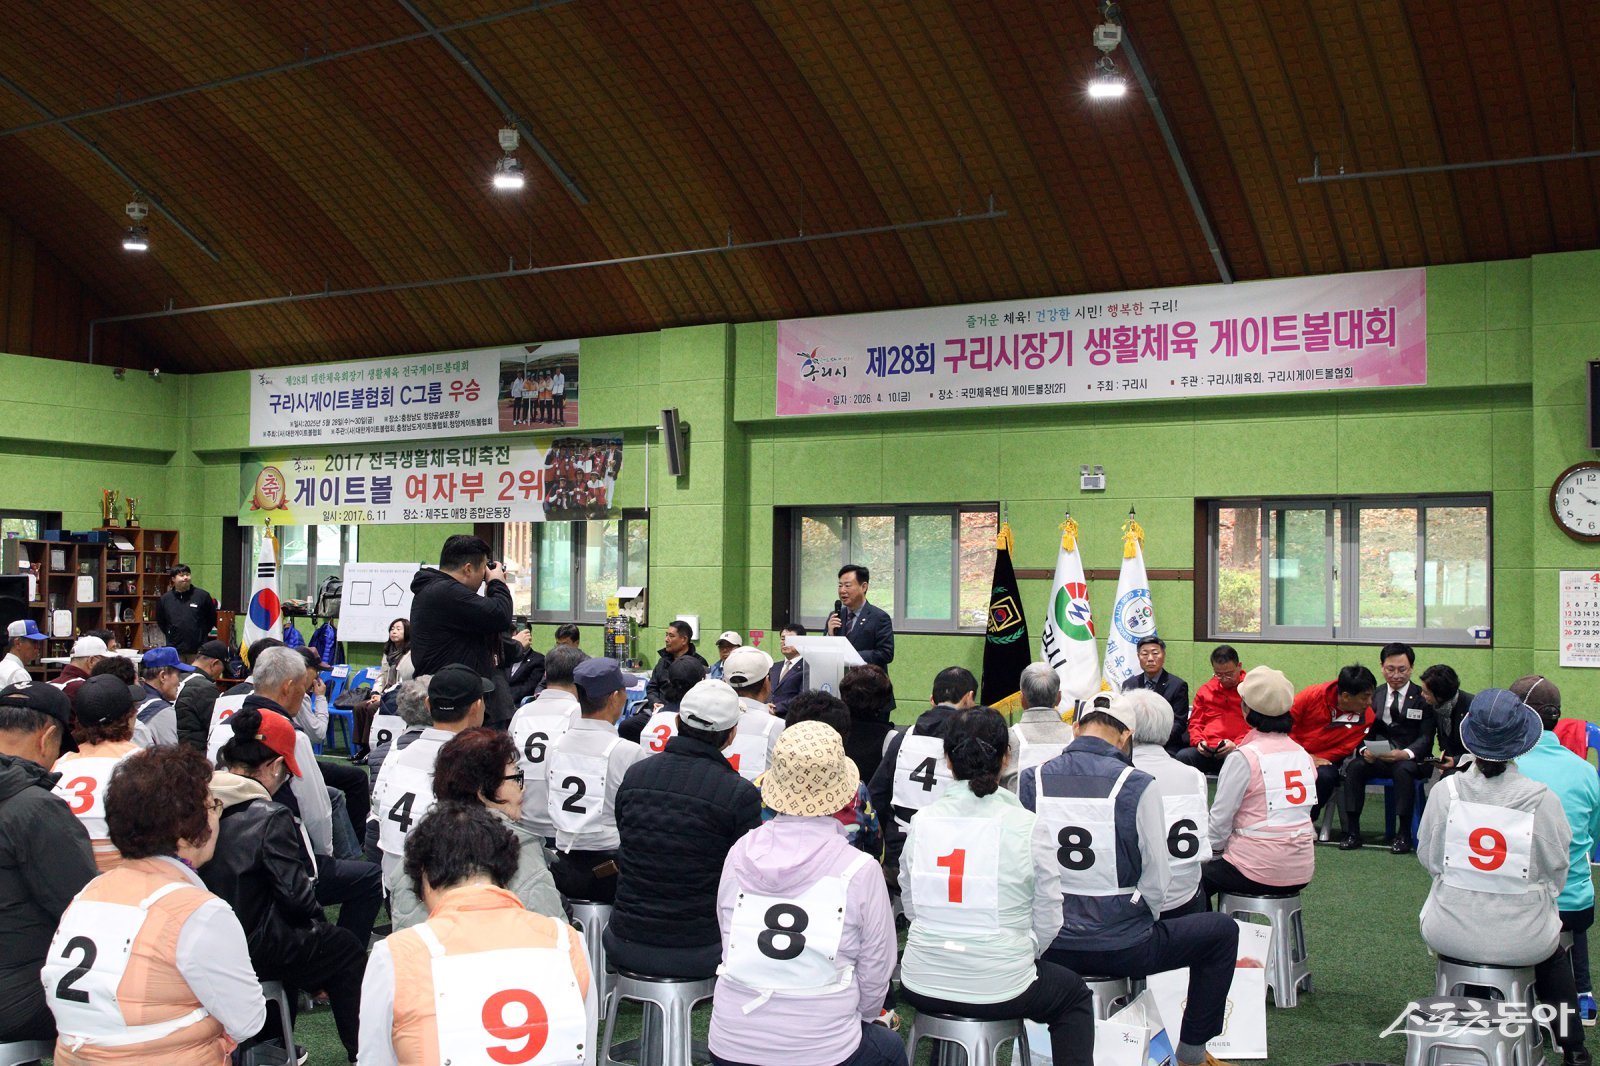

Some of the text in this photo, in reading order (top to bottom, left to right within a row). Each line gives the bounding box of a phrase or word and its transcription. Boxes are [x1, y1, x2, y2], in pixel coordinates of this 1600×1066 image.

[966, 300, 1178, 329] 즐거운 체육! 건강한 시민! 행복한 구리!
[865, 307, 1396, 378] 제28회 구리시장기 생활체육 게이트볼대회
[402, 360, 469, 378] 전국게이트볼대회
[1096, 380, 1113, 391] 주최
[1122, 378, 1148, 390] 구리시
[1180, 376, 1199, 388] 주관
[1267, 367, 1353, 383] 구리시게이트볼협회
[269, 379, 480, 414] 구리시게이트볼협회 C그룹 우승
[833, 395, 847, 405] 일자
[938, 389, 953, 401] 장소
[961, 386, 1008, 399] 국민체육센터
[325, 445, 510, 472] 2017 전국생활체육대축전
[261, 474, 280, 503] 축
[293, 469, 543, 507] 게이트볼 여자부 2위
[323, 511, 337, 522] 일시
[403, 508, 419, 520] 장소
[425, 507, 449, 520] 제주도
[469, 506, 511, 519] 종합운동장
[524, 732, 549, 763] 6
[649, 724, 672, 752] 3
[909, 757, 937, 791] 4
[1284, 770, 1307, 804] 5
[65, 776, 97, 814] 3
[388, 792, 416, 832] 4
[561, 776, 588, 814] 2
[1056, 826, 1096, 870] 8
[1167, 819, 1199, 859] 6
[1468, 828, 1507, 871] 9
[936, 849, 966, 903] 1
[757, 903, 809, 960] 8
[55, 936, 97, 1003] 2
[481, 988, 549, 1064] 9
